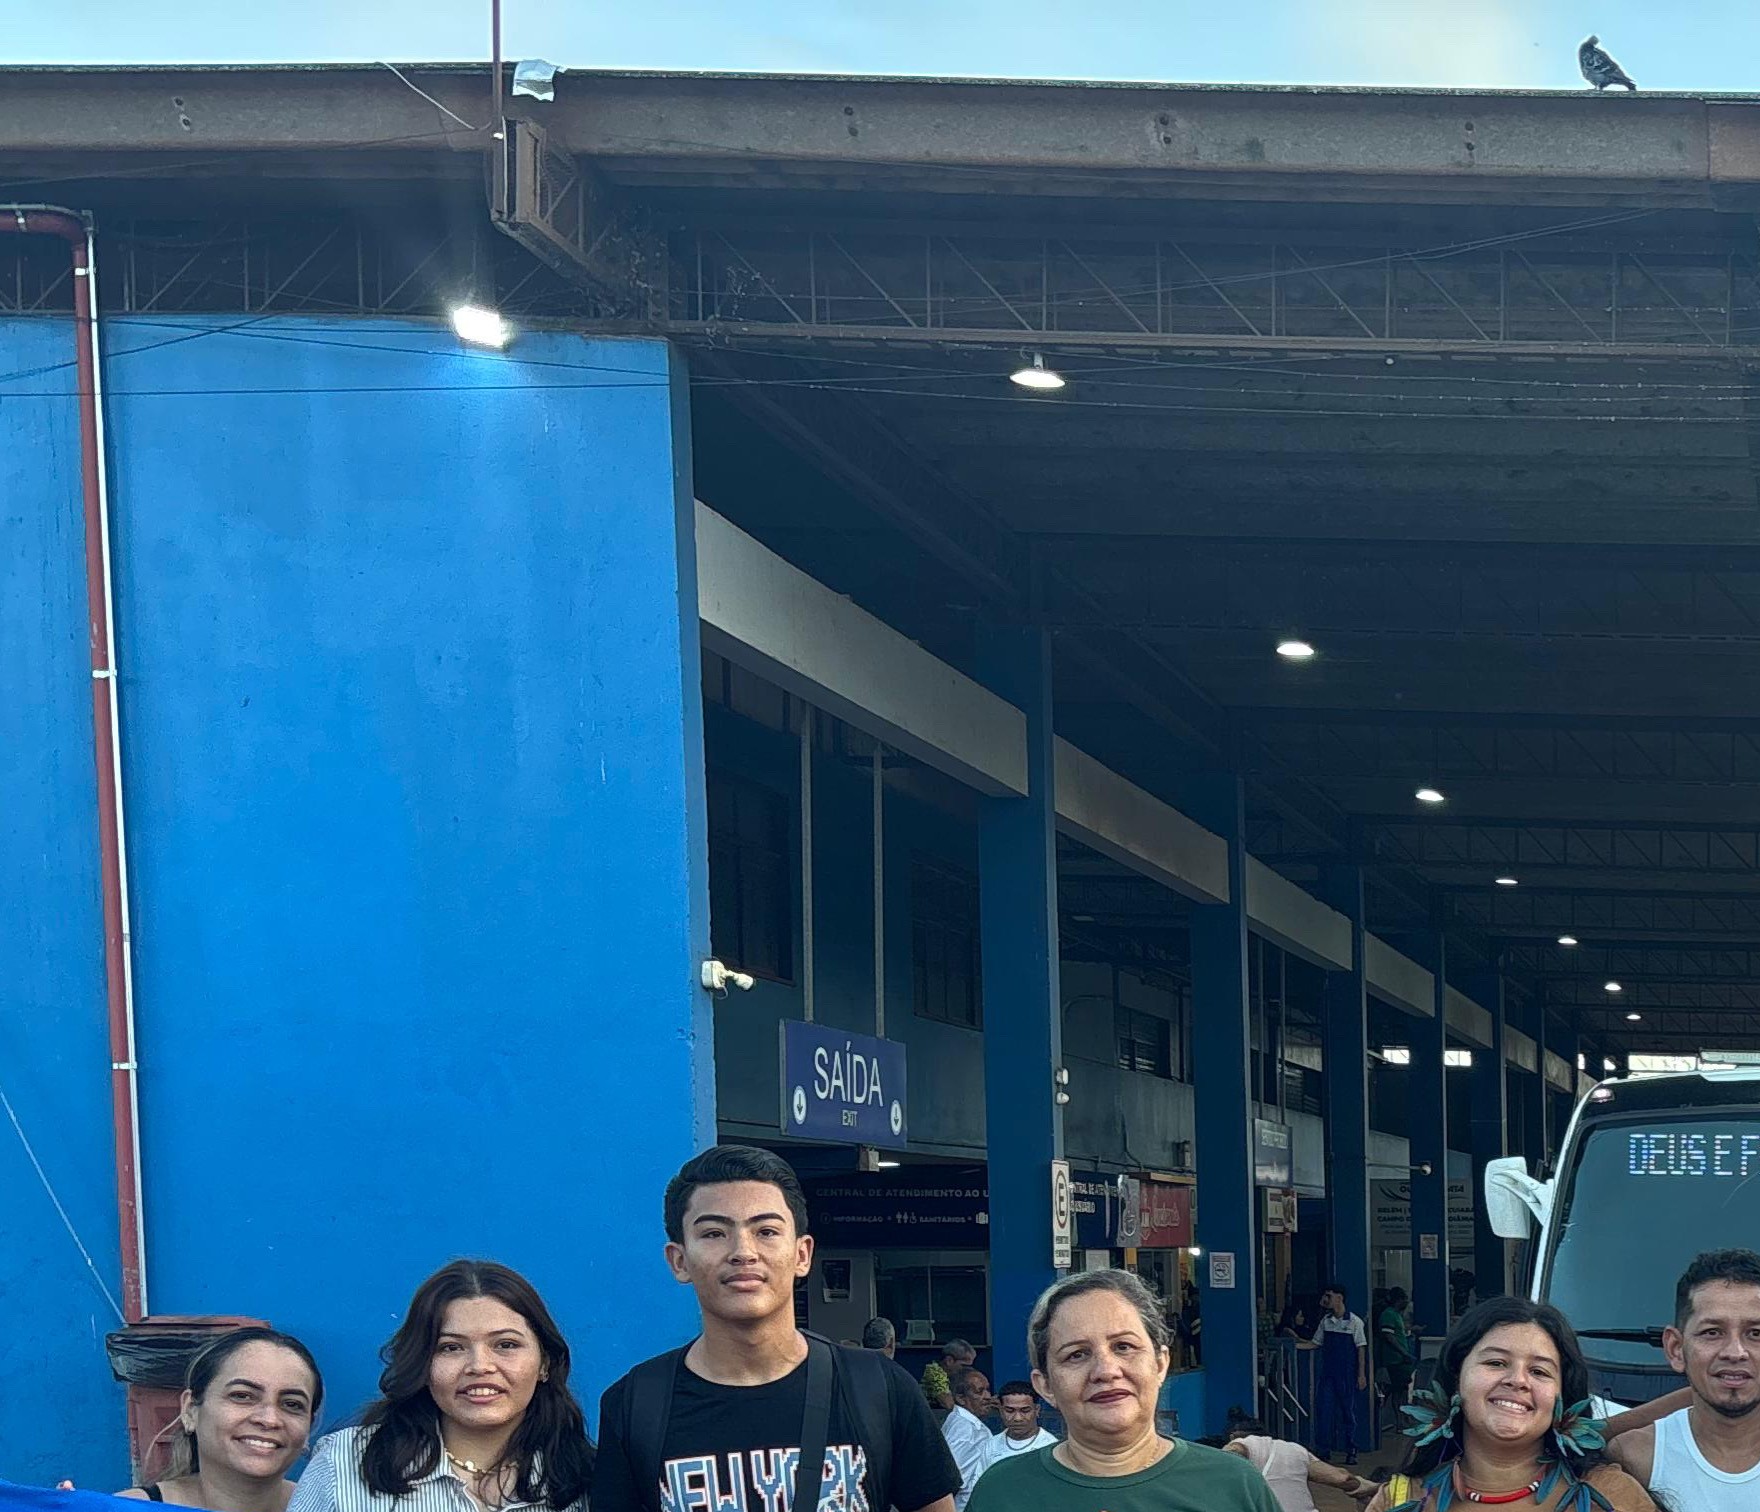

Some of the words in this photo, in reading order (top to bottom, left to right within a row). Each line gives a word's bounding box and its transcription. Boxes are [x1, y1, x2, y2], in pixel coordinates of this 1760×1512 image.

[814, 1040, 883, 1107] SAÍDA
[842, 1109, 857, 1126] EXIT
[1629, 1133, 1706, 1175] DEUS
[1714, 1134, 1733, 1176] E
[816, 1188, 864, 1197] CENTRAL
[868, 1188, 882, 1197] DE
[885, 1188, 962, 1198] ATENDIMENTO
[964, 1189, 980, 1198] AO
[833, 1214, 883, 1223] INFORMAÇÃO
